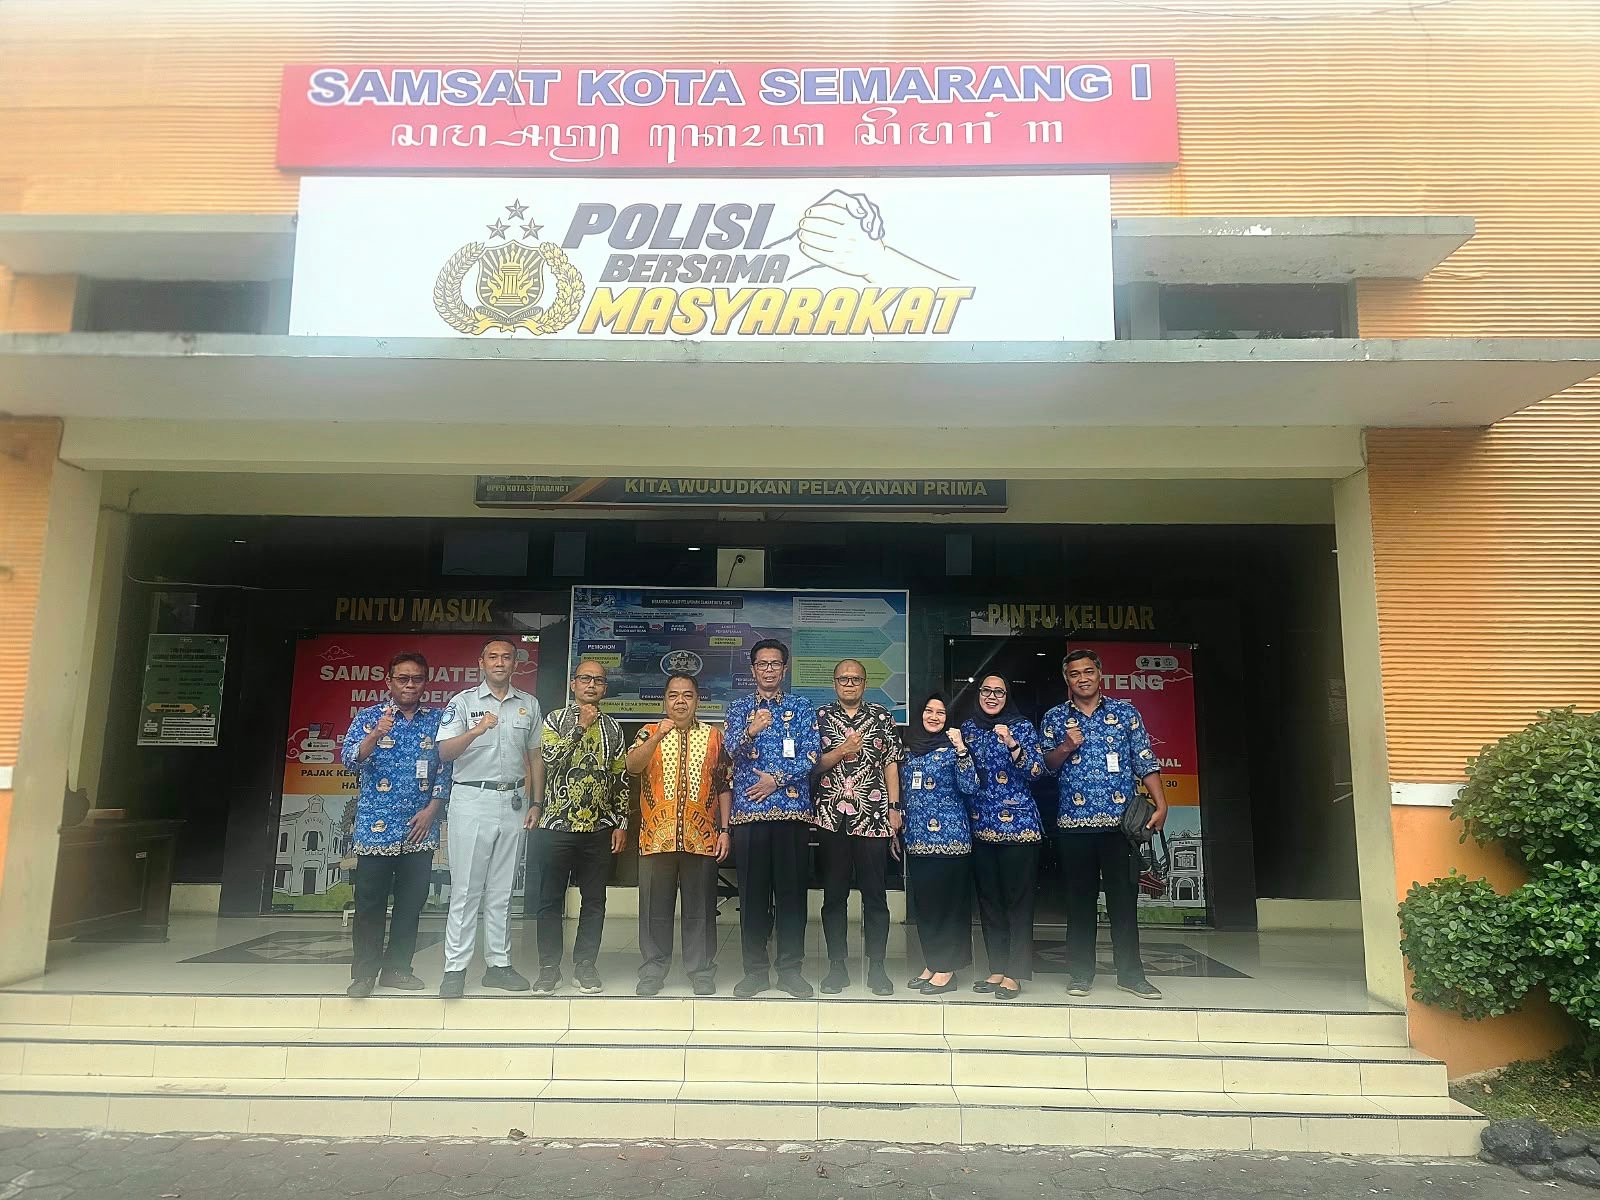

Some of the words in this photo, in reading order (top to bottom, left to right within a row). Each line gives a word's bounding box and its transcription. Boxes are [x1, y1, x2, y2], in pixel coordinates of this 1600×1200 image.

[307, 68, 561, 106] SAMSAT
[577, 68, 746, 106] KOTA
[759, 65, 1112, 104] SEMARANG
[1131, 64, 1151, 100] I
[561, 202, 774, 249] POLISI
[599, 253, 790, 283] BERSAMA
[577, 286, 977, 335] MASYARAKAT
[624, 479, 673, 494] KITA
[678, 479, 792, 495] WUJUDKAN
[798, 480, 918, 496] PELAYANAN
[923, 480, 989, 497] PRIMA
[335, 597, 405, 621] PINTU
[411, 598, 493, 622] MASUK
[988, 603, 1056, 629] PINTU
[1064, 604, 1156, 630] KELUAR
[320, 665, 391, 681] SAMS
[1100, 674, 1164, 690] TENG
[351, 689, 391, 702] MAK
[420, 690, 455, 703] DEK
[301, 769, 333, 777] PAJAK
[1166, 780, 1178, 788] 30
